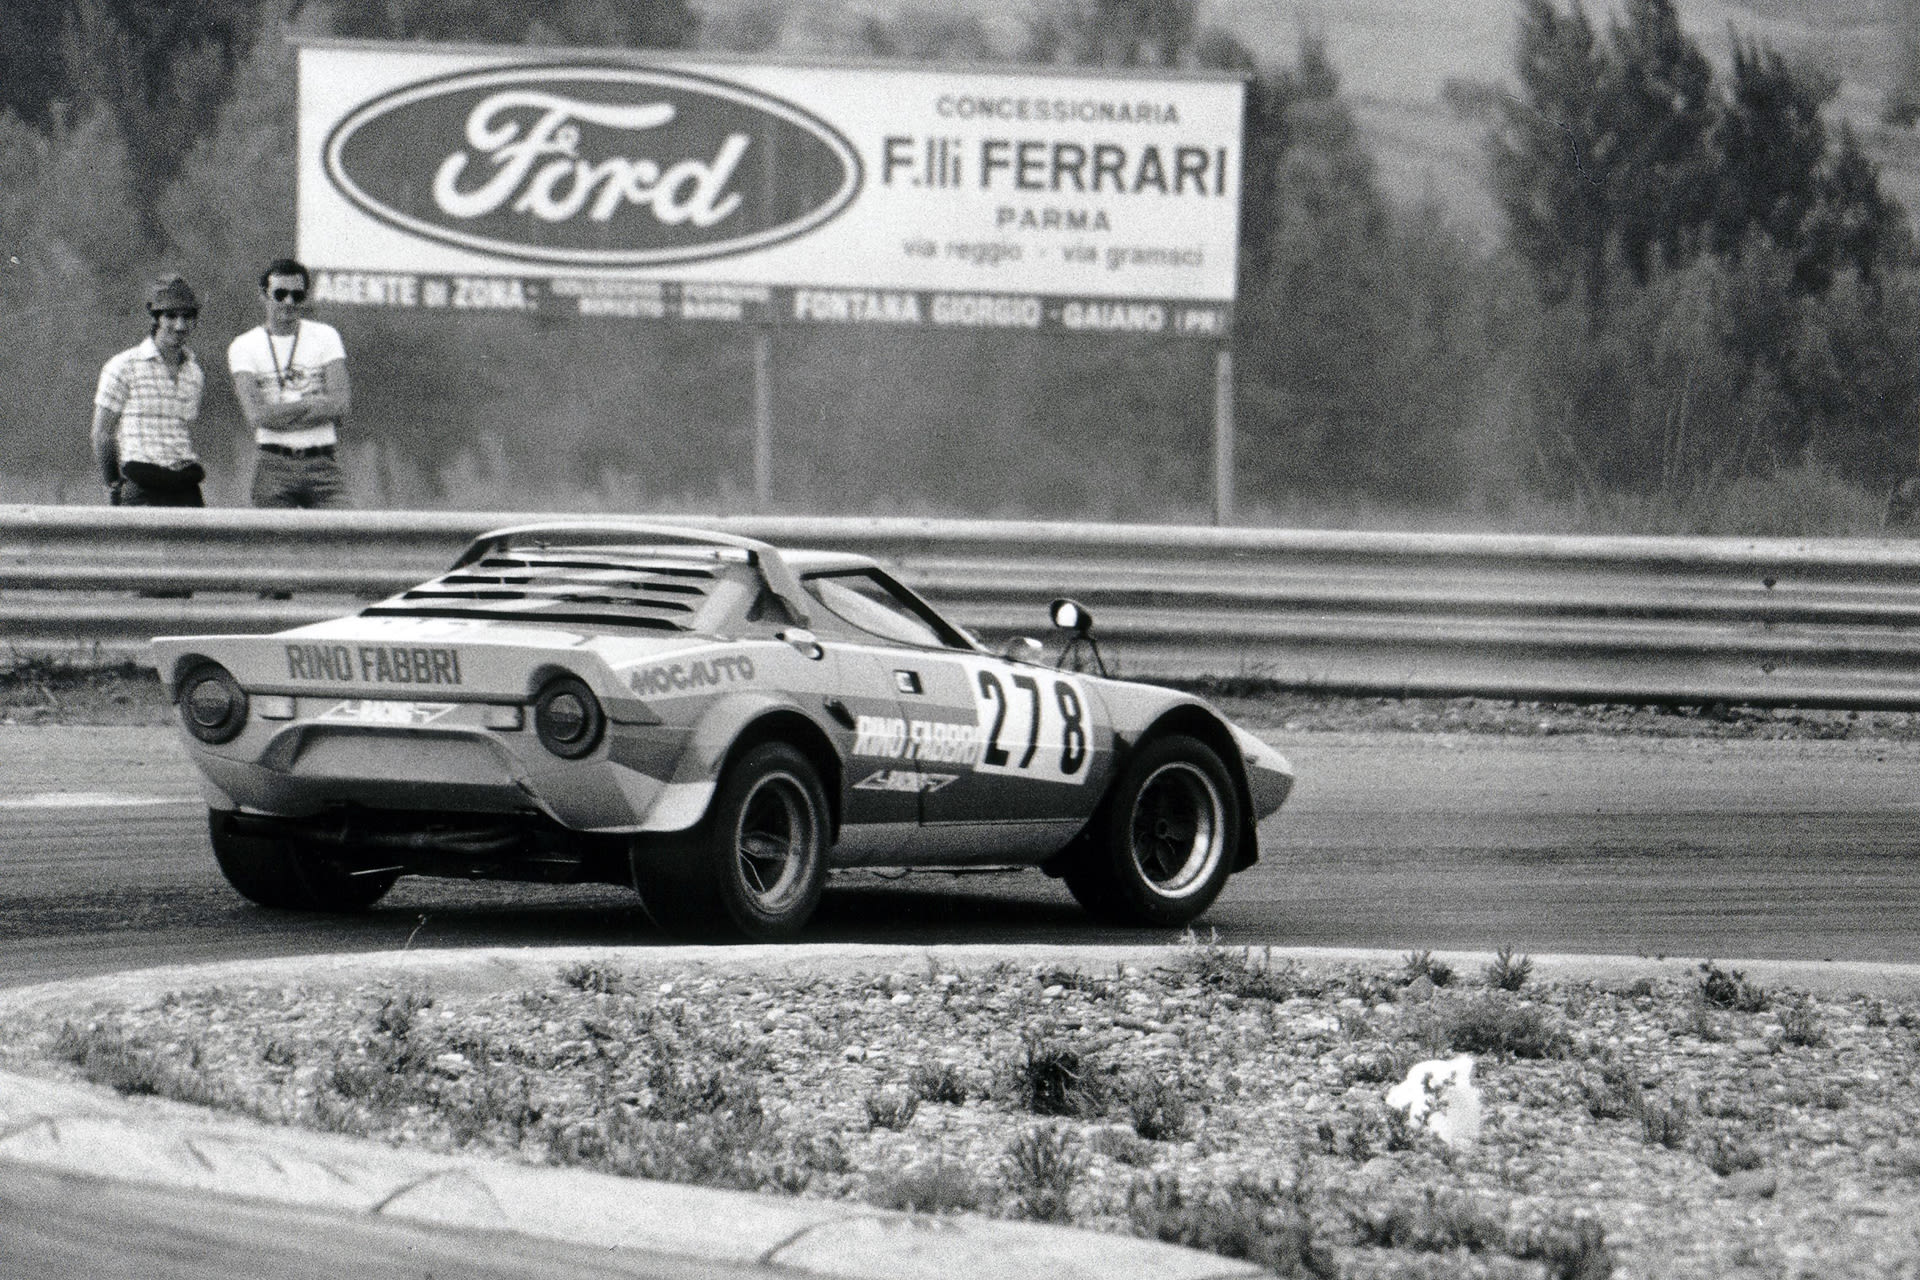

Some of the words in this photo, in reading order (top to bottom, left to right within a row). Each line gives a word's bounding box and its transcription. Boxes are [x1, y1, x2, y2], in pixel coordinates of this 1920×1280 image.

[935, 94, 1179, 125] CONCESSIONARIA
[433, 91, 749, 224] Ford
[881, 136, 962, 187] F.lli
[980, 140, 1227, 195] FERRARI
[995, 206, 1112, 232] PARMA
[902, 238, 937, 257] via
[944, 240, 1023, 267] reggio
[1061, 238, 1097, 263] via
[313, 272, 418, 306] AGENTE
[795, 291, 920, 324] FONTANA
[932, 295, 1042, 328] GIORGIO
[1063, 302, 1165, 332] GAIANO
[285, 644, 352, 681] RINO
[358, 646, 462, 685] FABBRI
[852, 715, 906, 758] RINO
[978, 670, 1085, 775] 278
